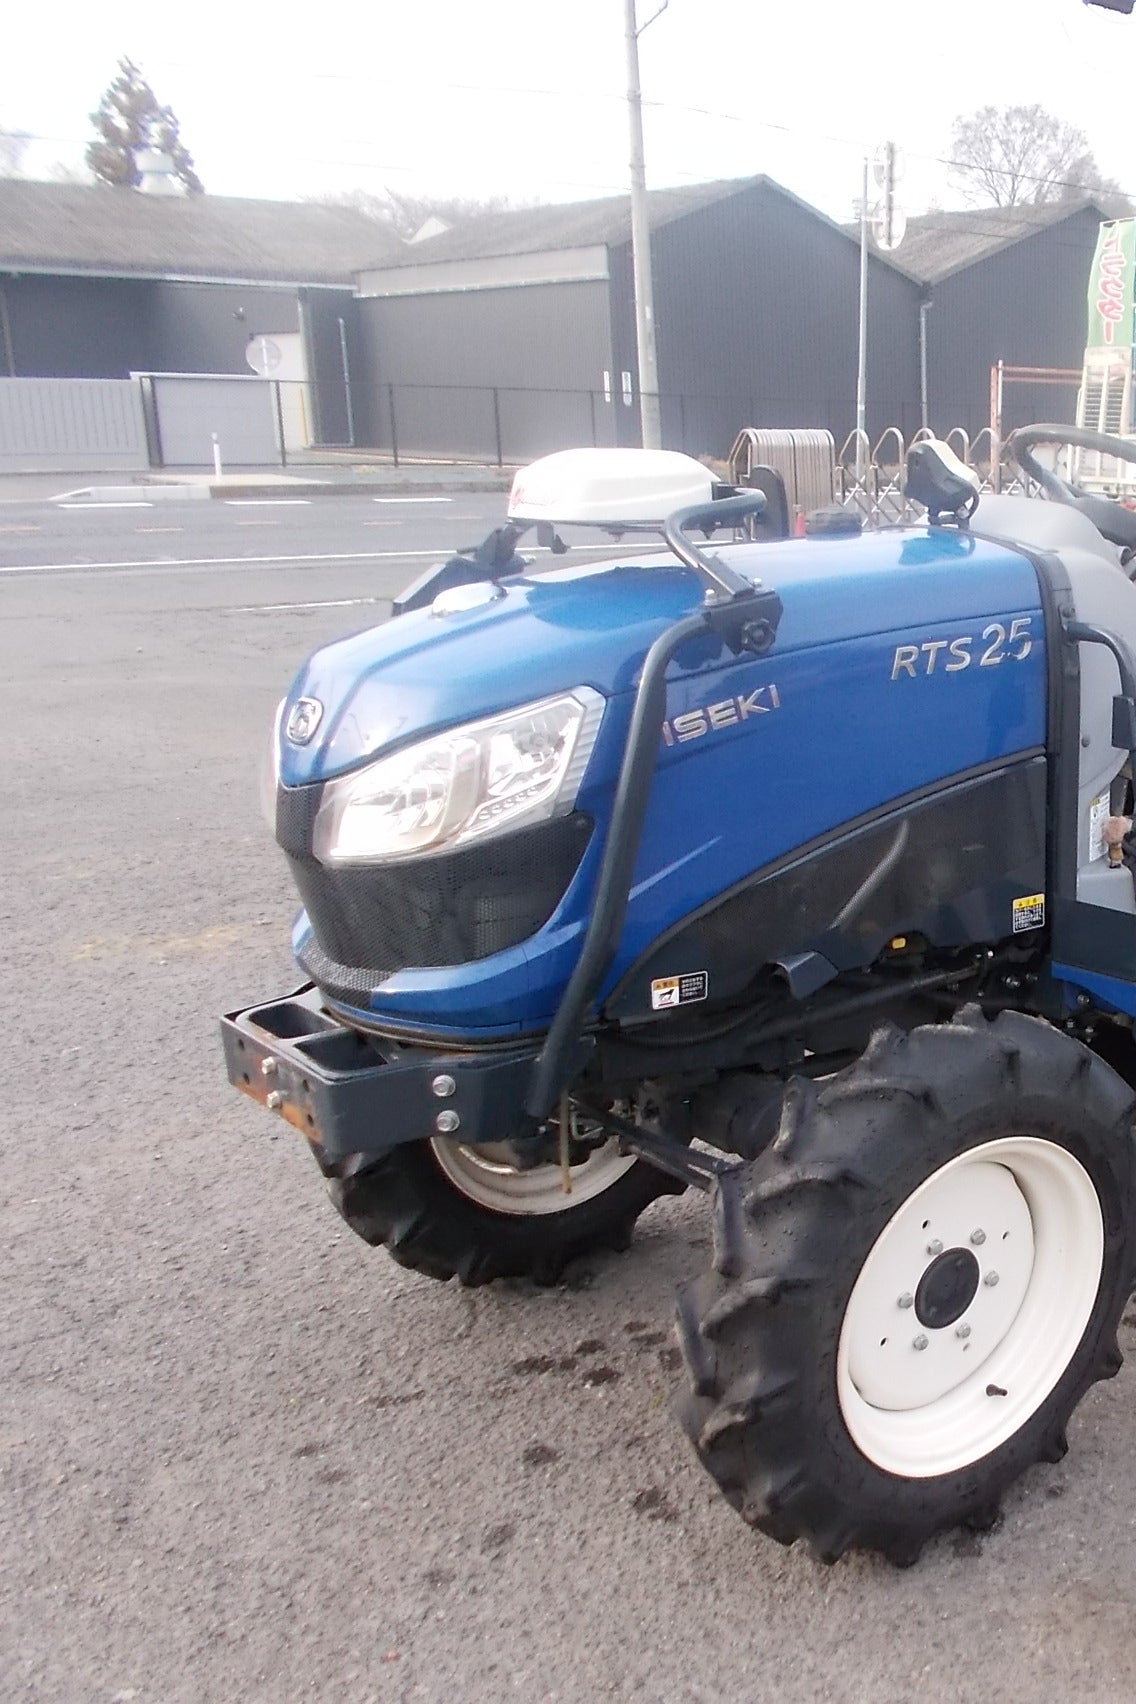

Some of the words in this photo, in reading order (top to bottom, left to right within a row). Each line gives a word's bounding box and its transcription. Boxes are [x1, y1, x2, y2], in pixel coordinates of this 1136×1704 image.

[890, 637, 973, 680] RTS
[980, 618, 1032, 667] 25
[662, 685, 780, 746] ISEKI
